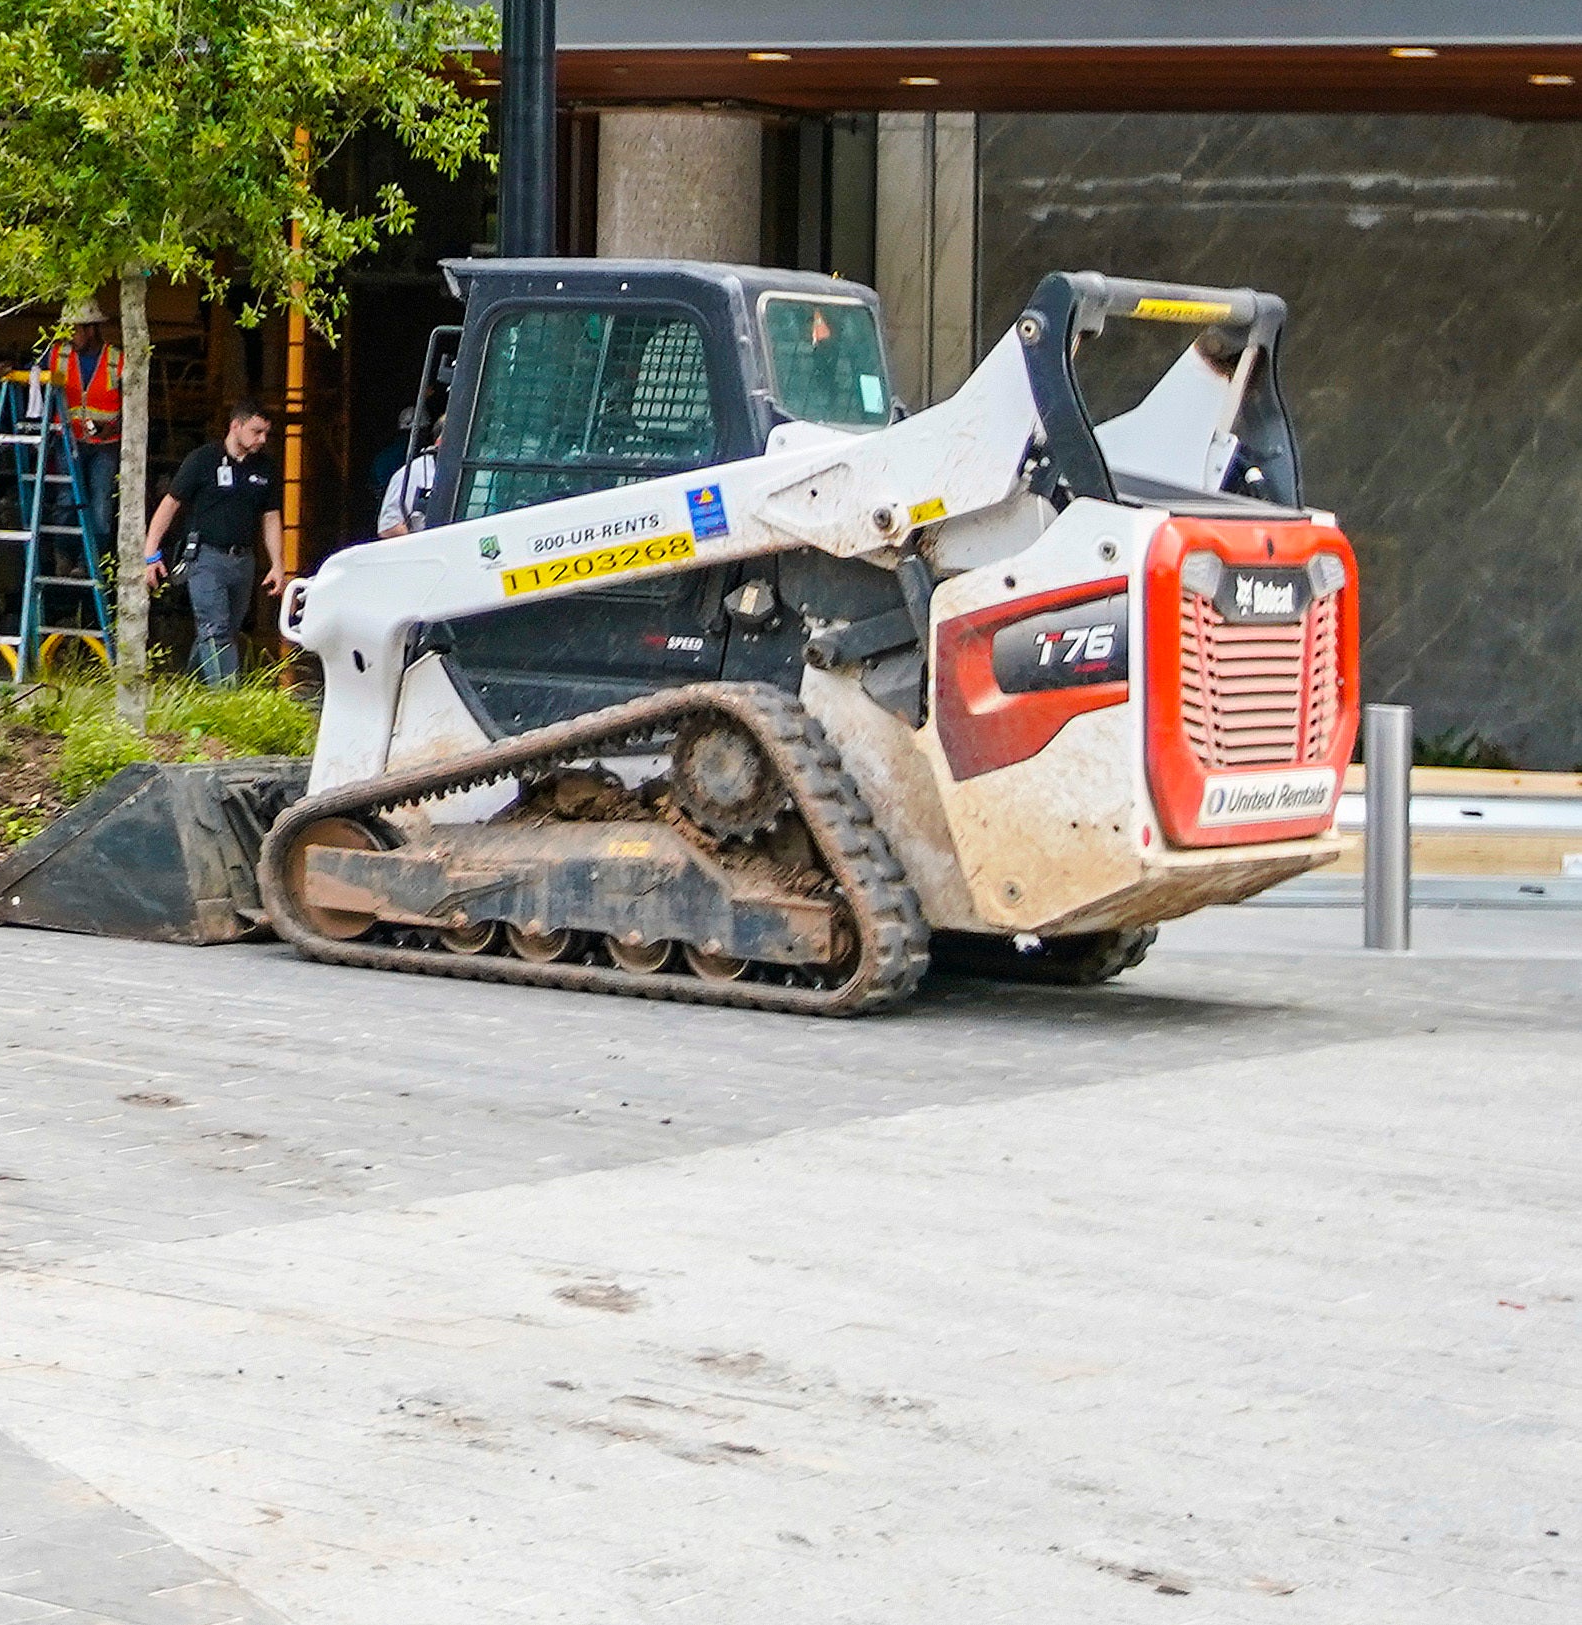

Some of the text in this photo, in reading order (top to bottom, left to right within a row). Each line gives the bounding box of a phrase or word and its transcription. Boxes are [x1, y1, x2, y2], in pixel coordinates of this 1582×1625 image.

[533, 513, 660, 554] 800-UR-RENTS
[504, 536, 691, 591] 11203268
[1034, 623, 1117, 666] T76
[1228, 781, 1328, 812] United Rentals
